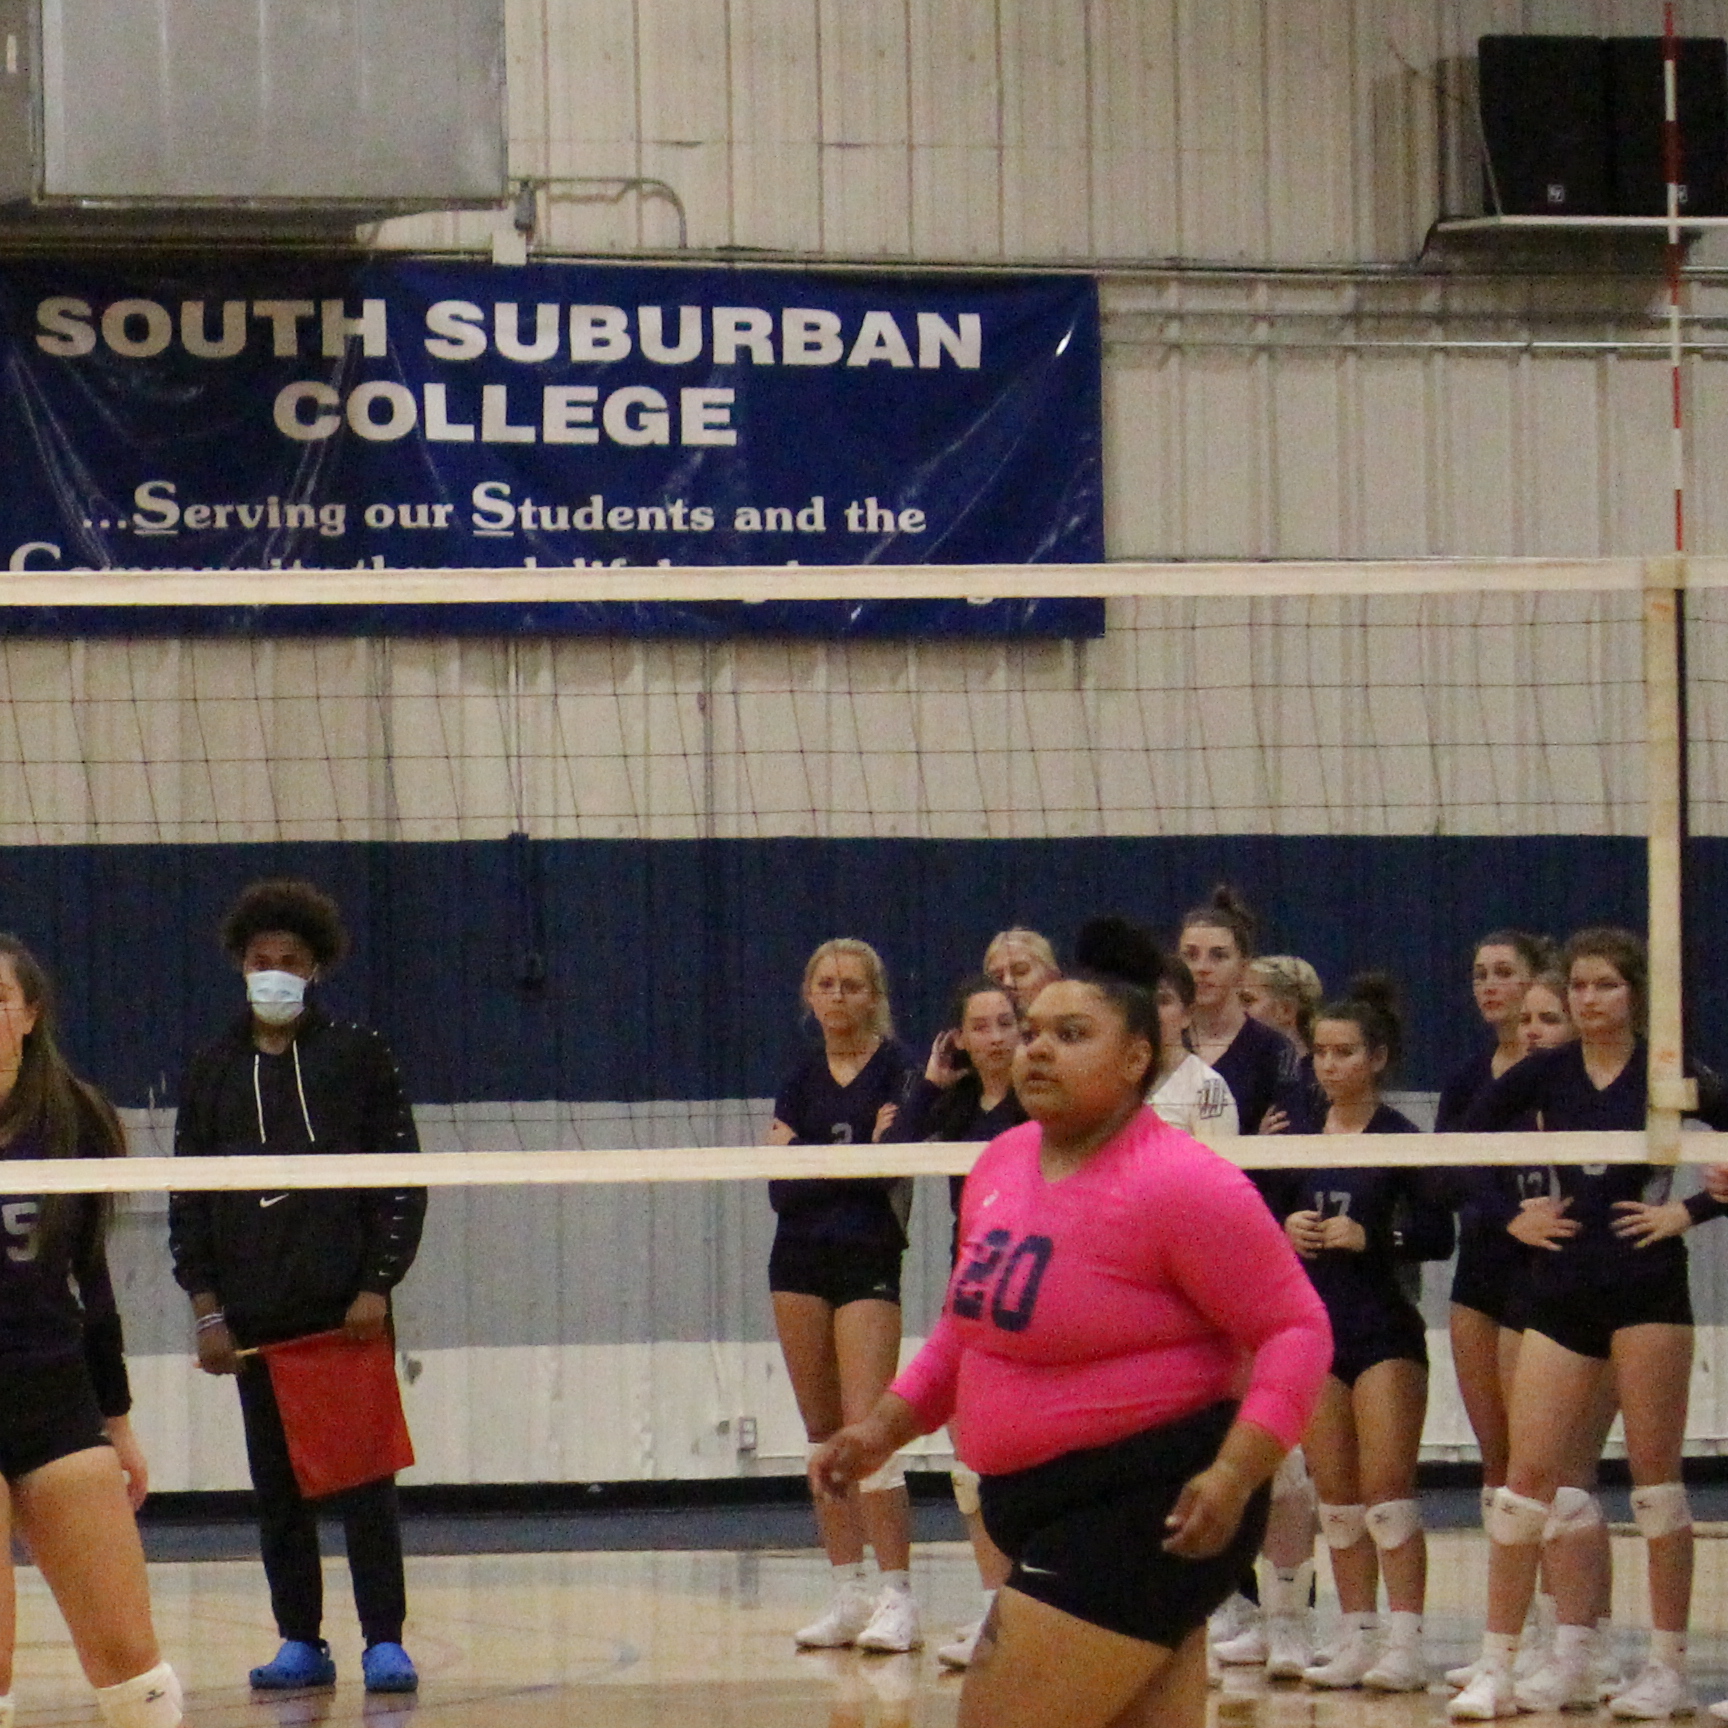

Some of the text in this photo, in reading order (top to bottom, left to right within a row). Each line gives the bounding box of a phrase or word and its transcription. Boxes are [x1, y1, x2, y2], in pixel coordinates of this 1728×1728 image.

[35, 296, 983, 369] SOUTH SUBURBAN
[272, 380, 738, 447] COLLEGE
[363, 502, 454, 530] our
[471, 481, 715, 537] Students
[733, 496, 827, 533] and
[845, 497, 928, 533] the
[1, 1201, 38, 1263] 5
[952, 1228, 1054, 1333] 20
